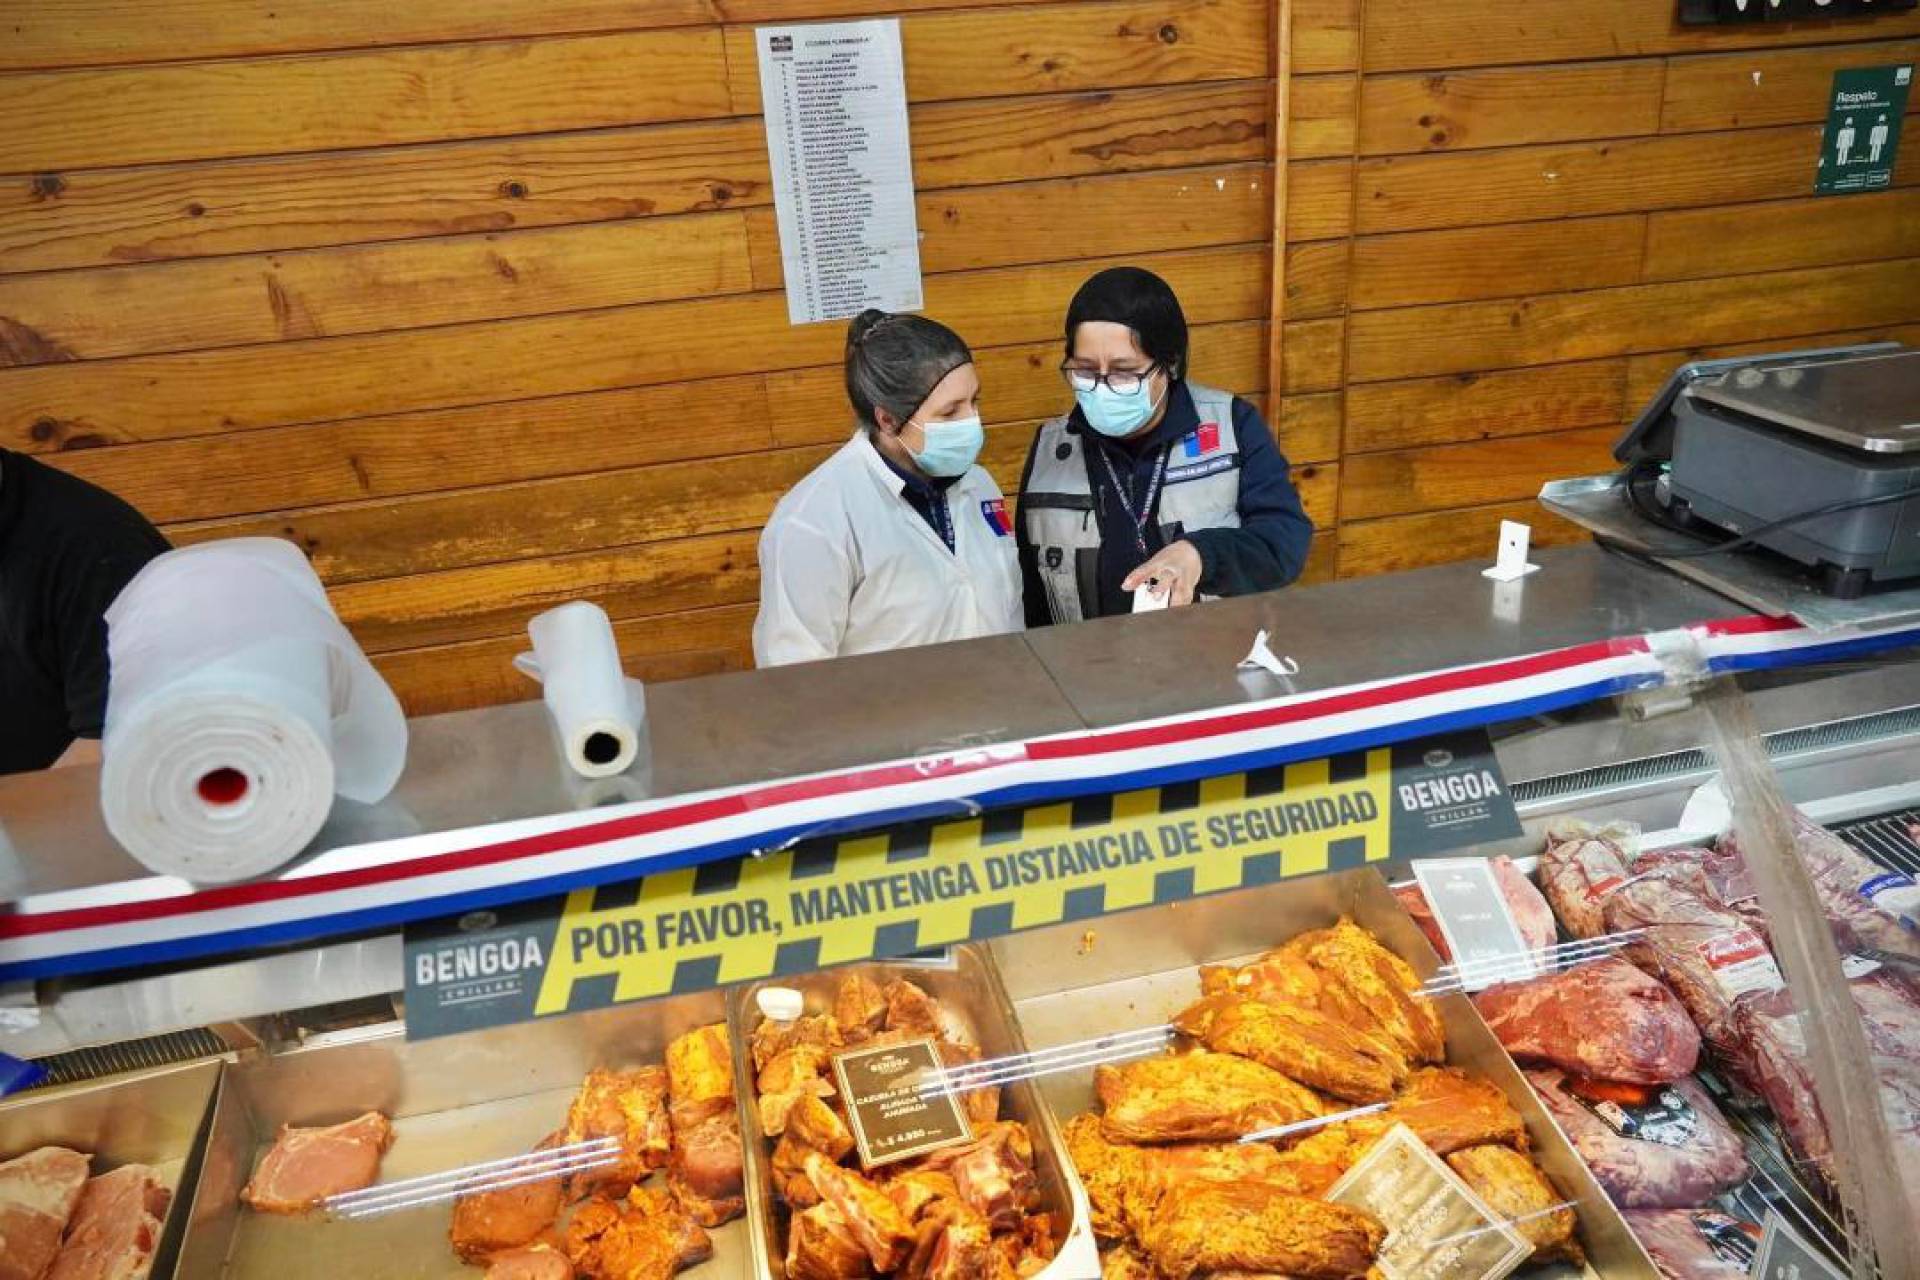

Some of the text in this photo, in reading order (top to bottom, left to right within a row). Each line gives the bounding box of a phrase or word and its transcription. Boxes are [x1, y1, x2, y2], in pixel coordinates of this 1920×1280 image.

[1836, 90, 1878, 104] Respeto
[1399, 770, 1501, 811] BENGOA
[571, 790, 1379, 963] POR FAVOR, MANTENGA DISTANCIA DE SEGURIDAD
[416, 936, 544, 985] BENGOA
